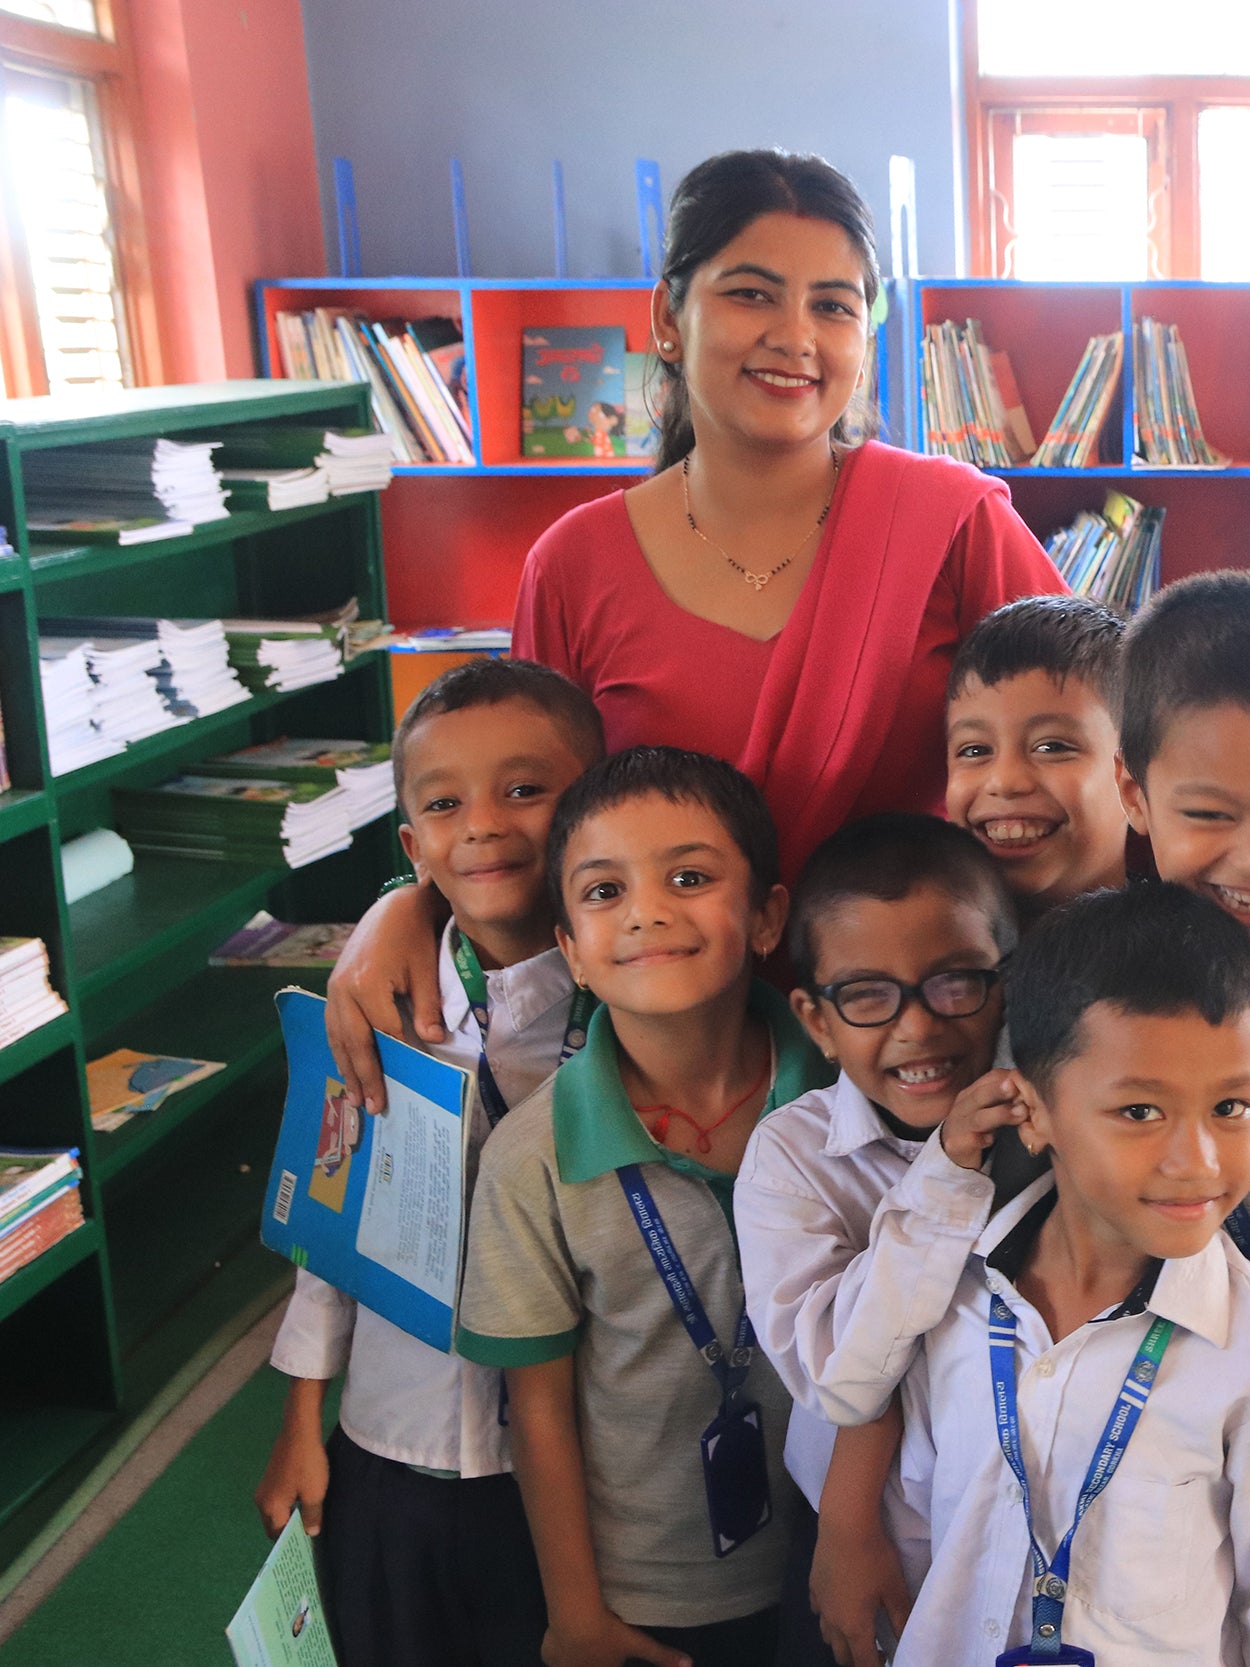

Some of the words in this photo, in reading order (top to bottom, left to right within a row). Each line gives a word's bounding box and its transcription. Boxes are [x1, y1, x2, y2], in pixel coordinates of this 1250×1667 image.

[632, 1192, 652, 1229] विद्यालय
[998, 1381, 1008, 1425] विद्यालय
[1089, 1441, 1115, 1493] SECONDARY
[1111, 1403, 1131, 1441] SCHOOL
[1109, 1448, 1122, 1472] GORKHA
